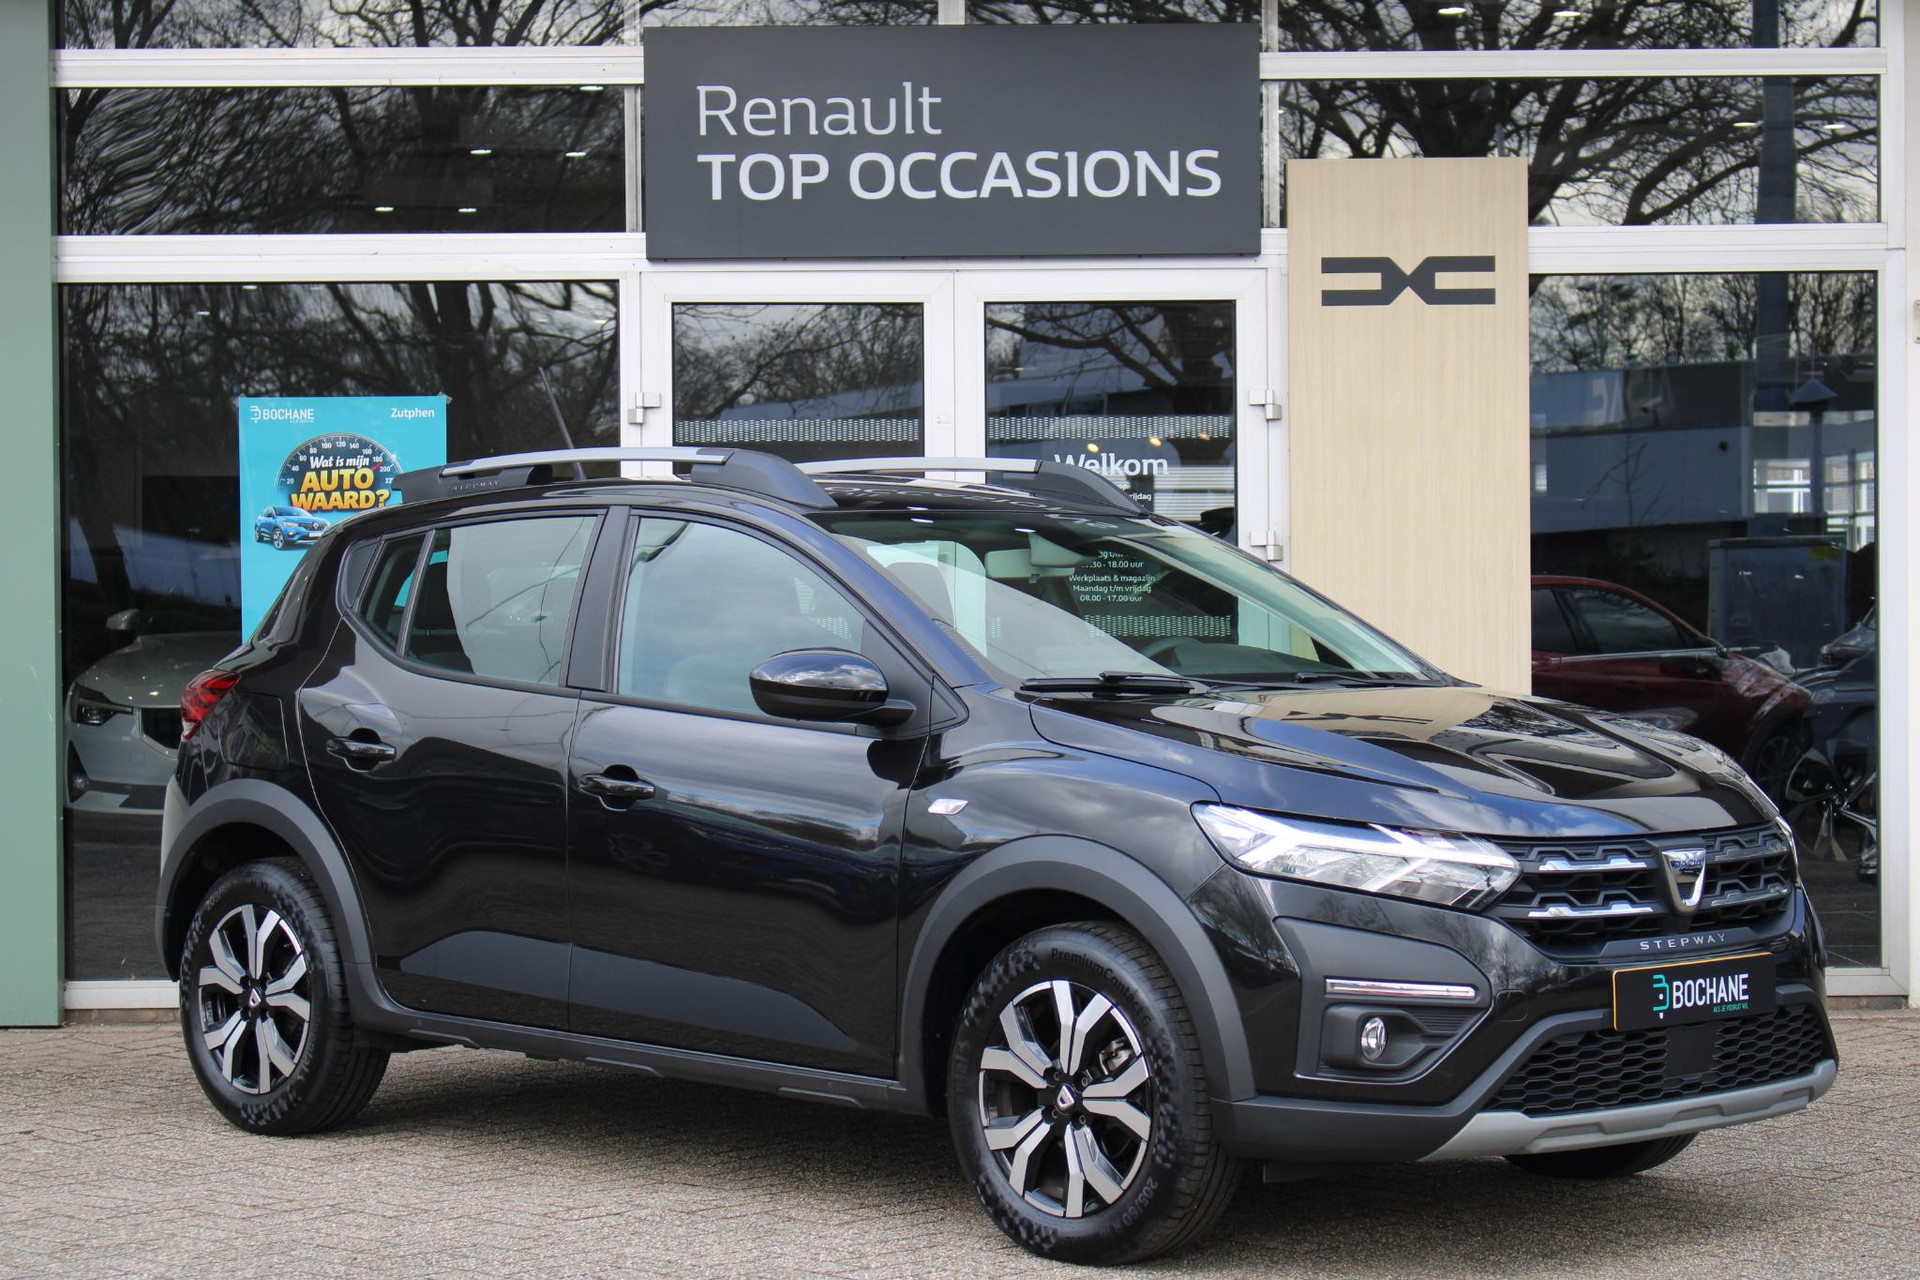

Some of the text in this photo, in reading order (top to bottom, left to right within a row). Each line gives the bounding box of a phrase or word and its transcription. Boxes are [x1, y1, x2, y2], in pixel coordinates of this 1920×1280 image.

[697, 81, 943, 136] Renault
[697, 149, 1222, 200] TOP OCCASIONS
[262, 408, 315, 420] BOCHANE
[390, 408, 435, 420] Zutphen
[309, 455, 369, 469] Wat is mijn
[300, 467, 374, 492] AUTO
[290, 489, 390, 511] WAARD?
[1069, 574, 1111, 583] Werkplaats
[1120, 574, 1156, 583] magazijn
[1073, 585, 1108, 593] Maandag
[1124, 585, 1152, 594] vrijdag
[1640, 932, 1726, 950] STEPWAY
[1051, 948, 1144, 1015] PremiumContact
[1672, 973, 1749, 1009] BOCHANE
